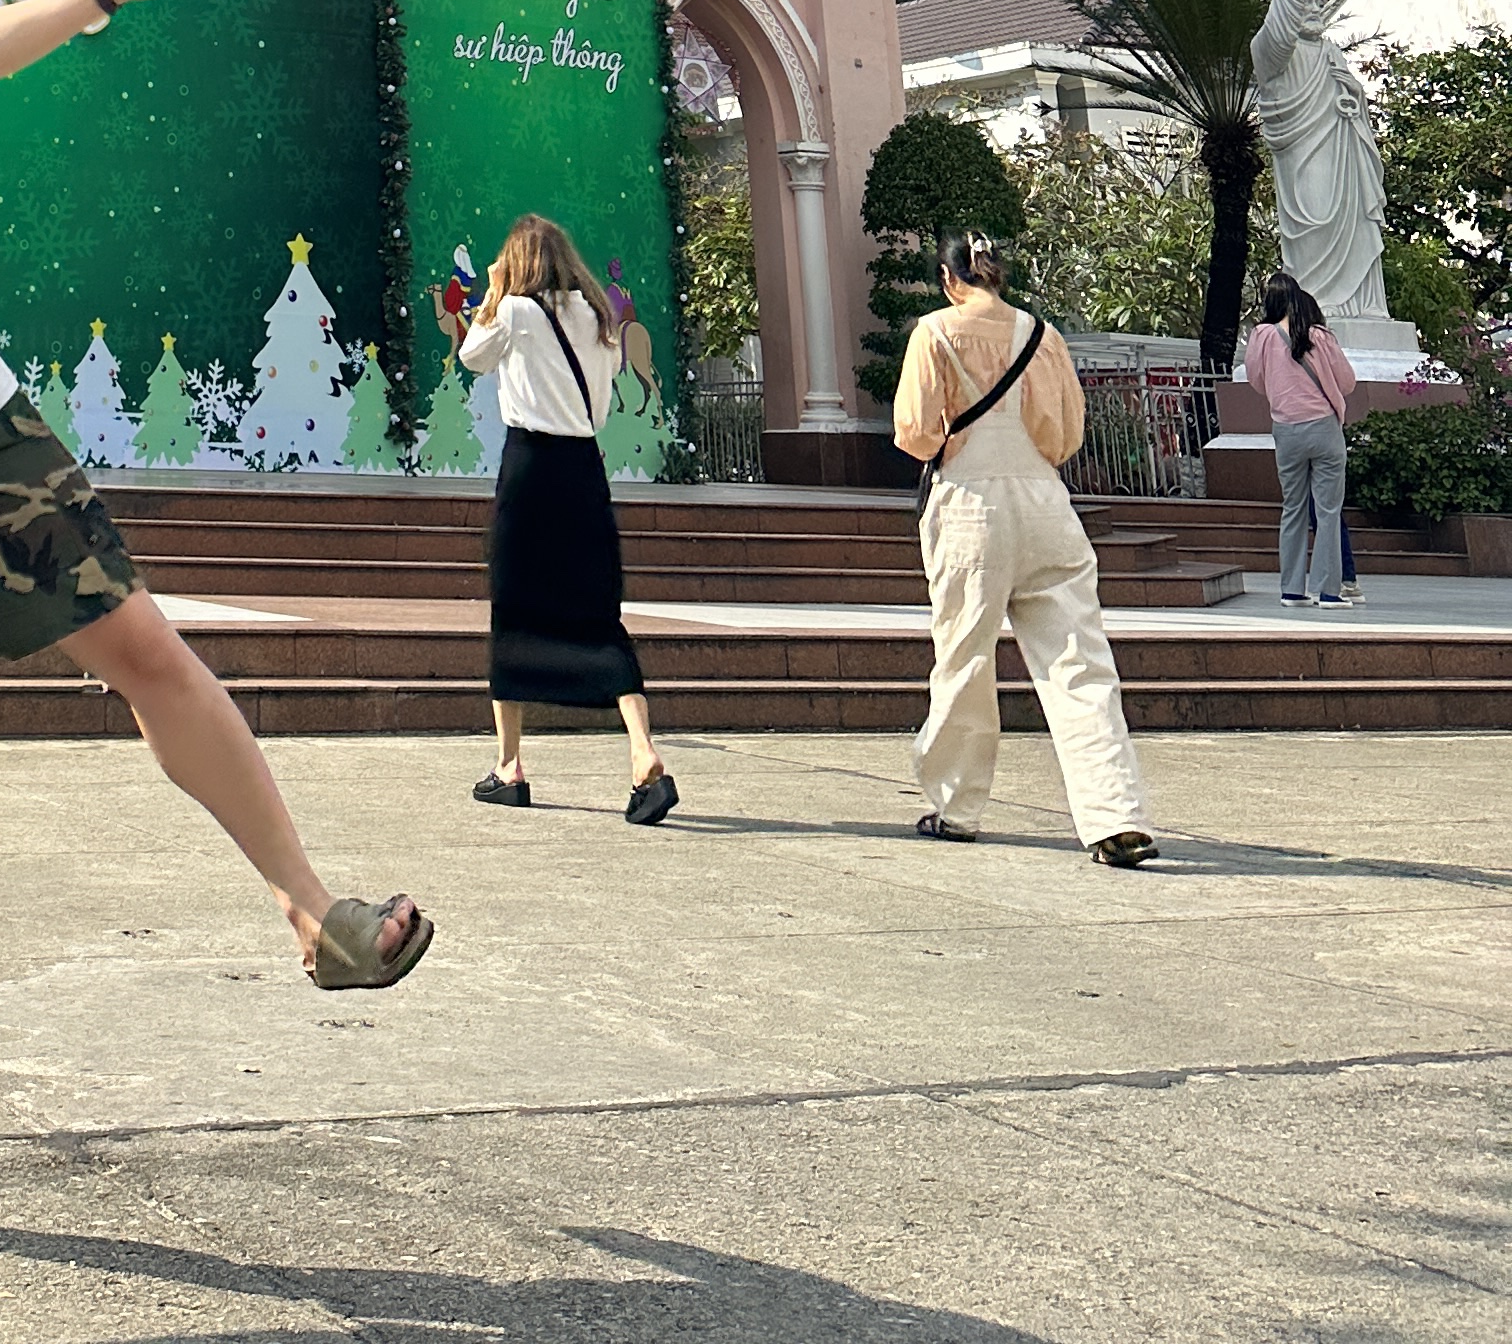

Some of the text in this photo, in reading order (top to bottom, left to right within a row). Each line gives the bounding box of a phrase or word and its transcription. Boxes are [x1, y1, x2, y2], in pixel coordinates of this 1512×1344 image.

[453, 22, 625, 94] sự hiệp thông
